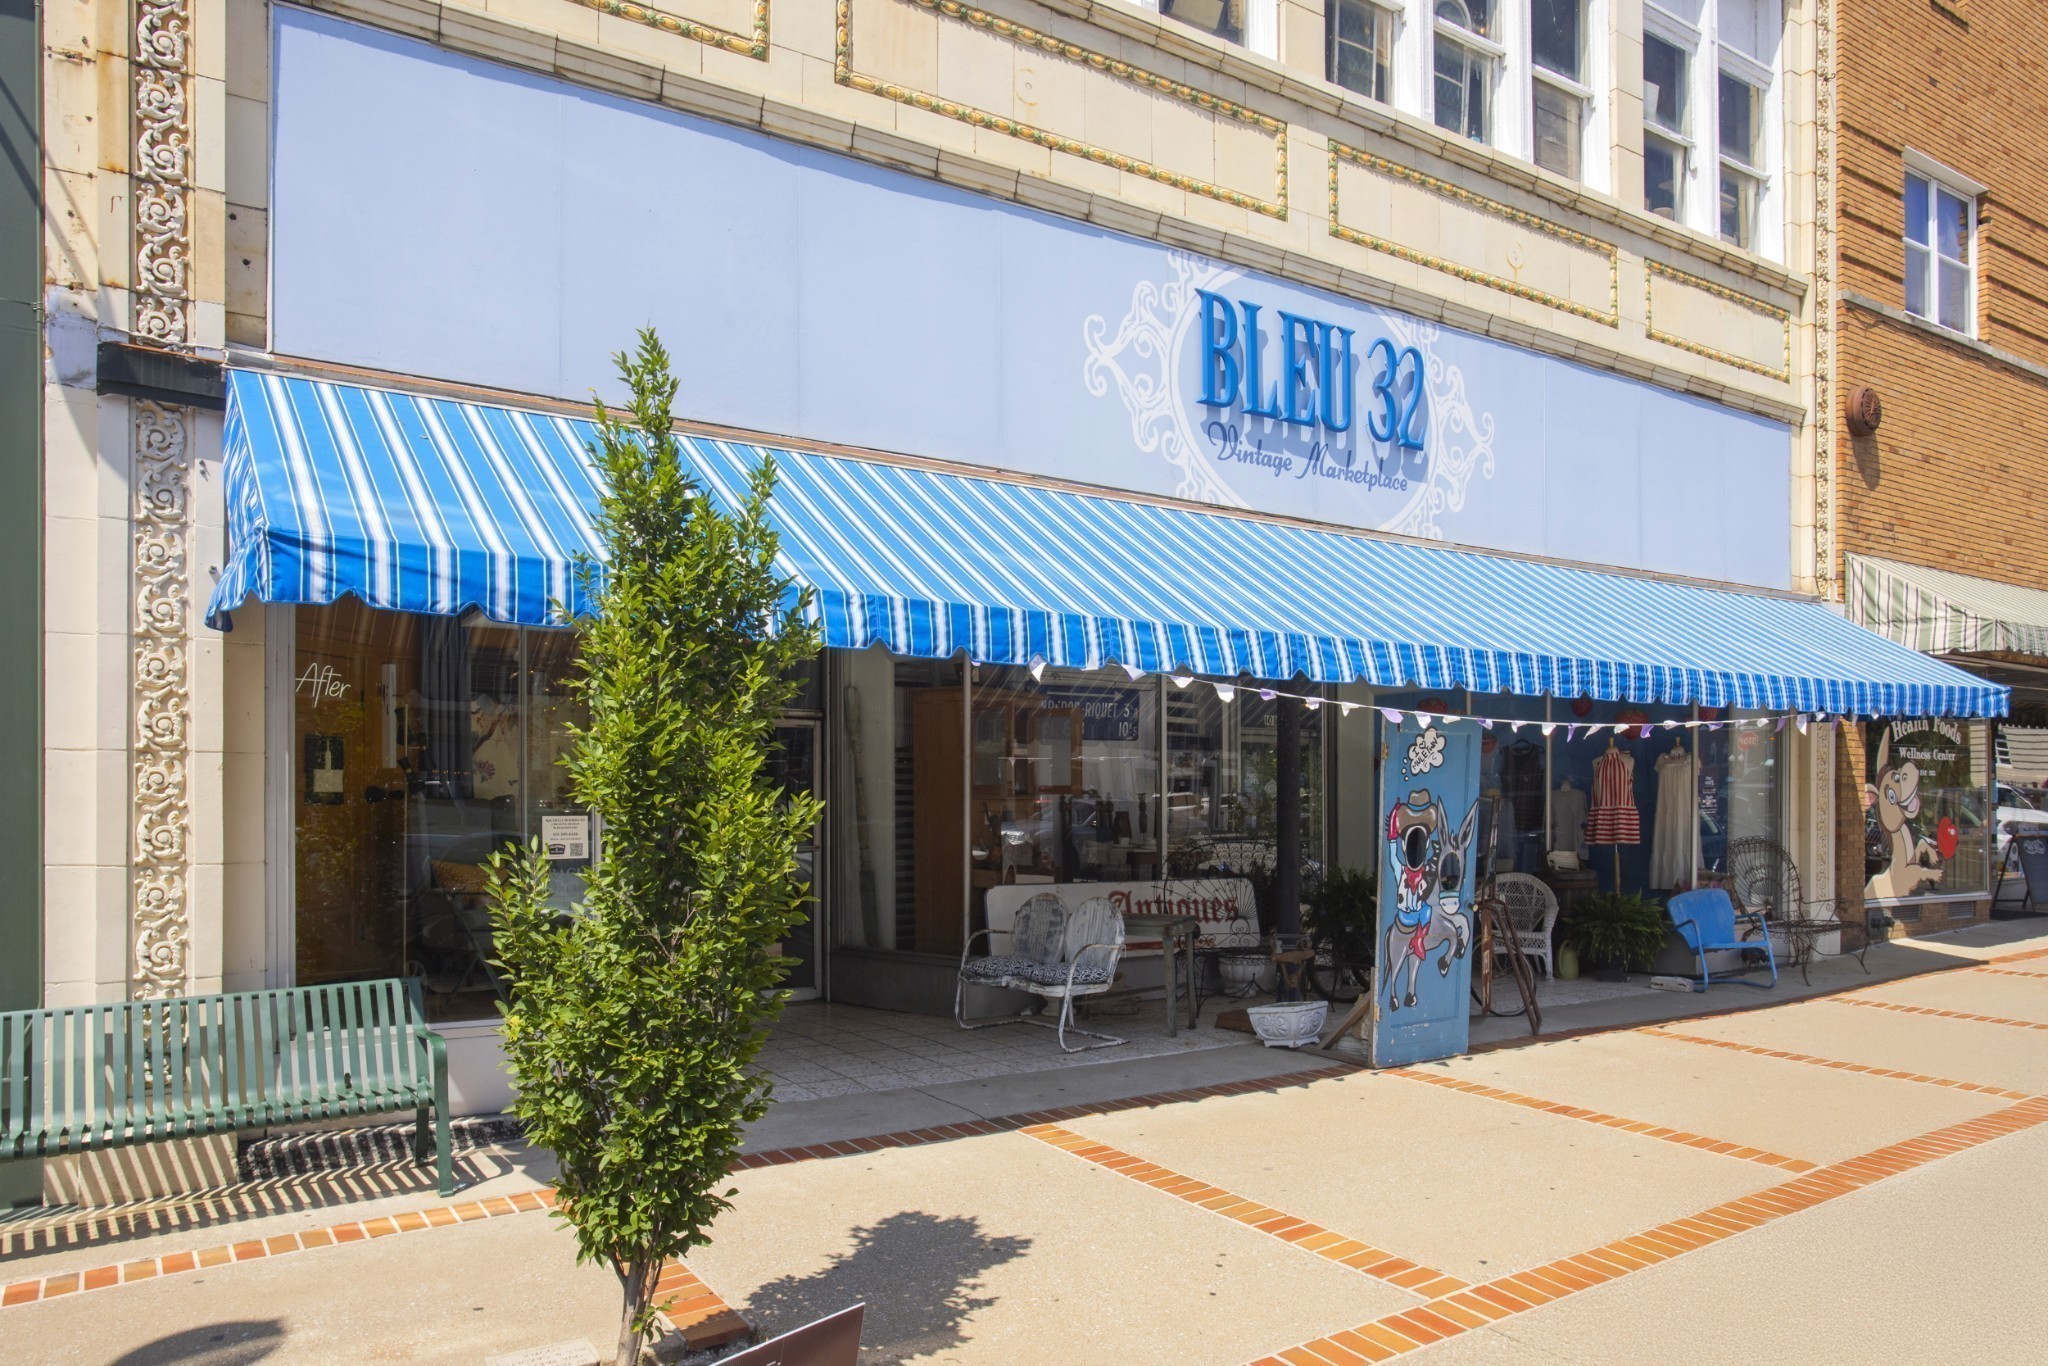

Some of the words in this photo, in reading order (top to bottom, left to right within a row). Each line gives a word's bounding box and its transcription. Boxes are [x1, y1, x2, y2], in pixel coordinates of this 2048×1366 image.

[1194, 288, 1356, 433] BLEU
[1367, 337, 1425, 451] 32
[1207, 421, 1293, 478] Vintage
[1295, 441, 1408, 492] Marketplace
[295, 662, 351, 708] After
[1899, 747, 1931, 760] Wellness
[1933, 749, 1956, 760] Center
[1933, 716, 1962, 745] Foods
